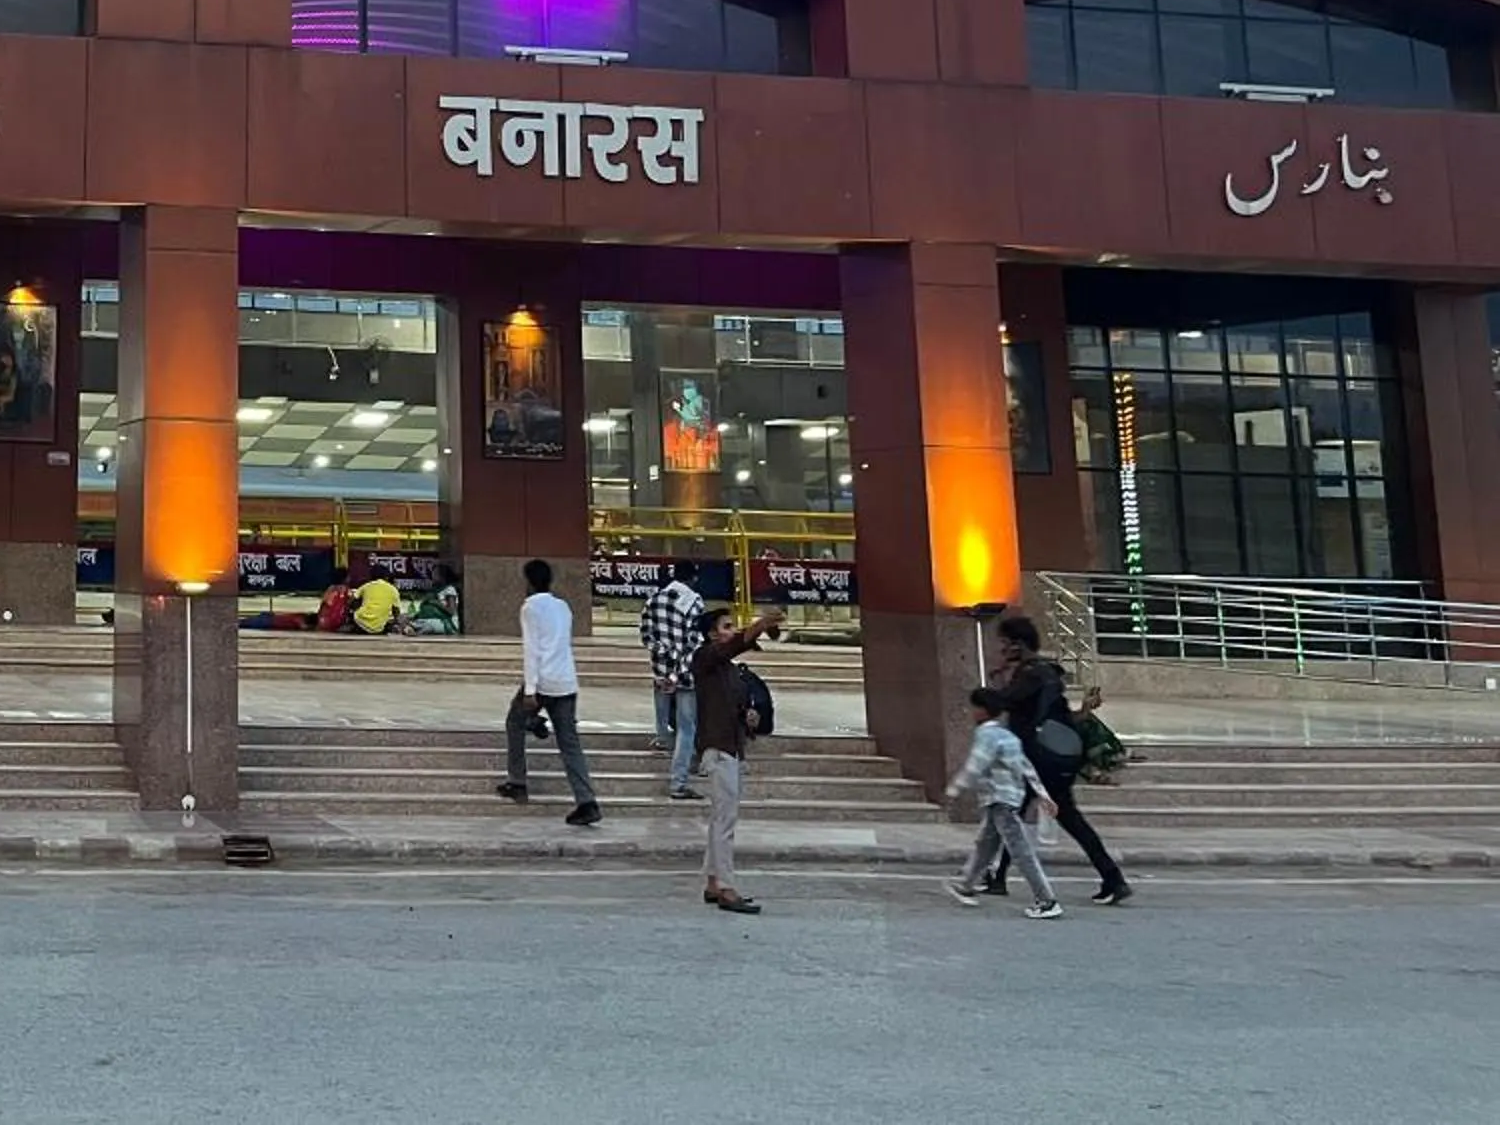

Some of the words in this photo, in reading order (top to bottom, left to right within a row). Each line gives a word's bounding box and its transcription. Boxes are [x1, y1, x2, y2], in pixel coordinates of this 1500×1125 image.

[439, 95, 704, 183] बनारस
[1225, 133, 1393, 215] بنارس
[615, 561, 661, 583] सुरक्षा
[767, 562, 806, 586] रेलवे
[808, 568, 851, 590] सुरक्षा
